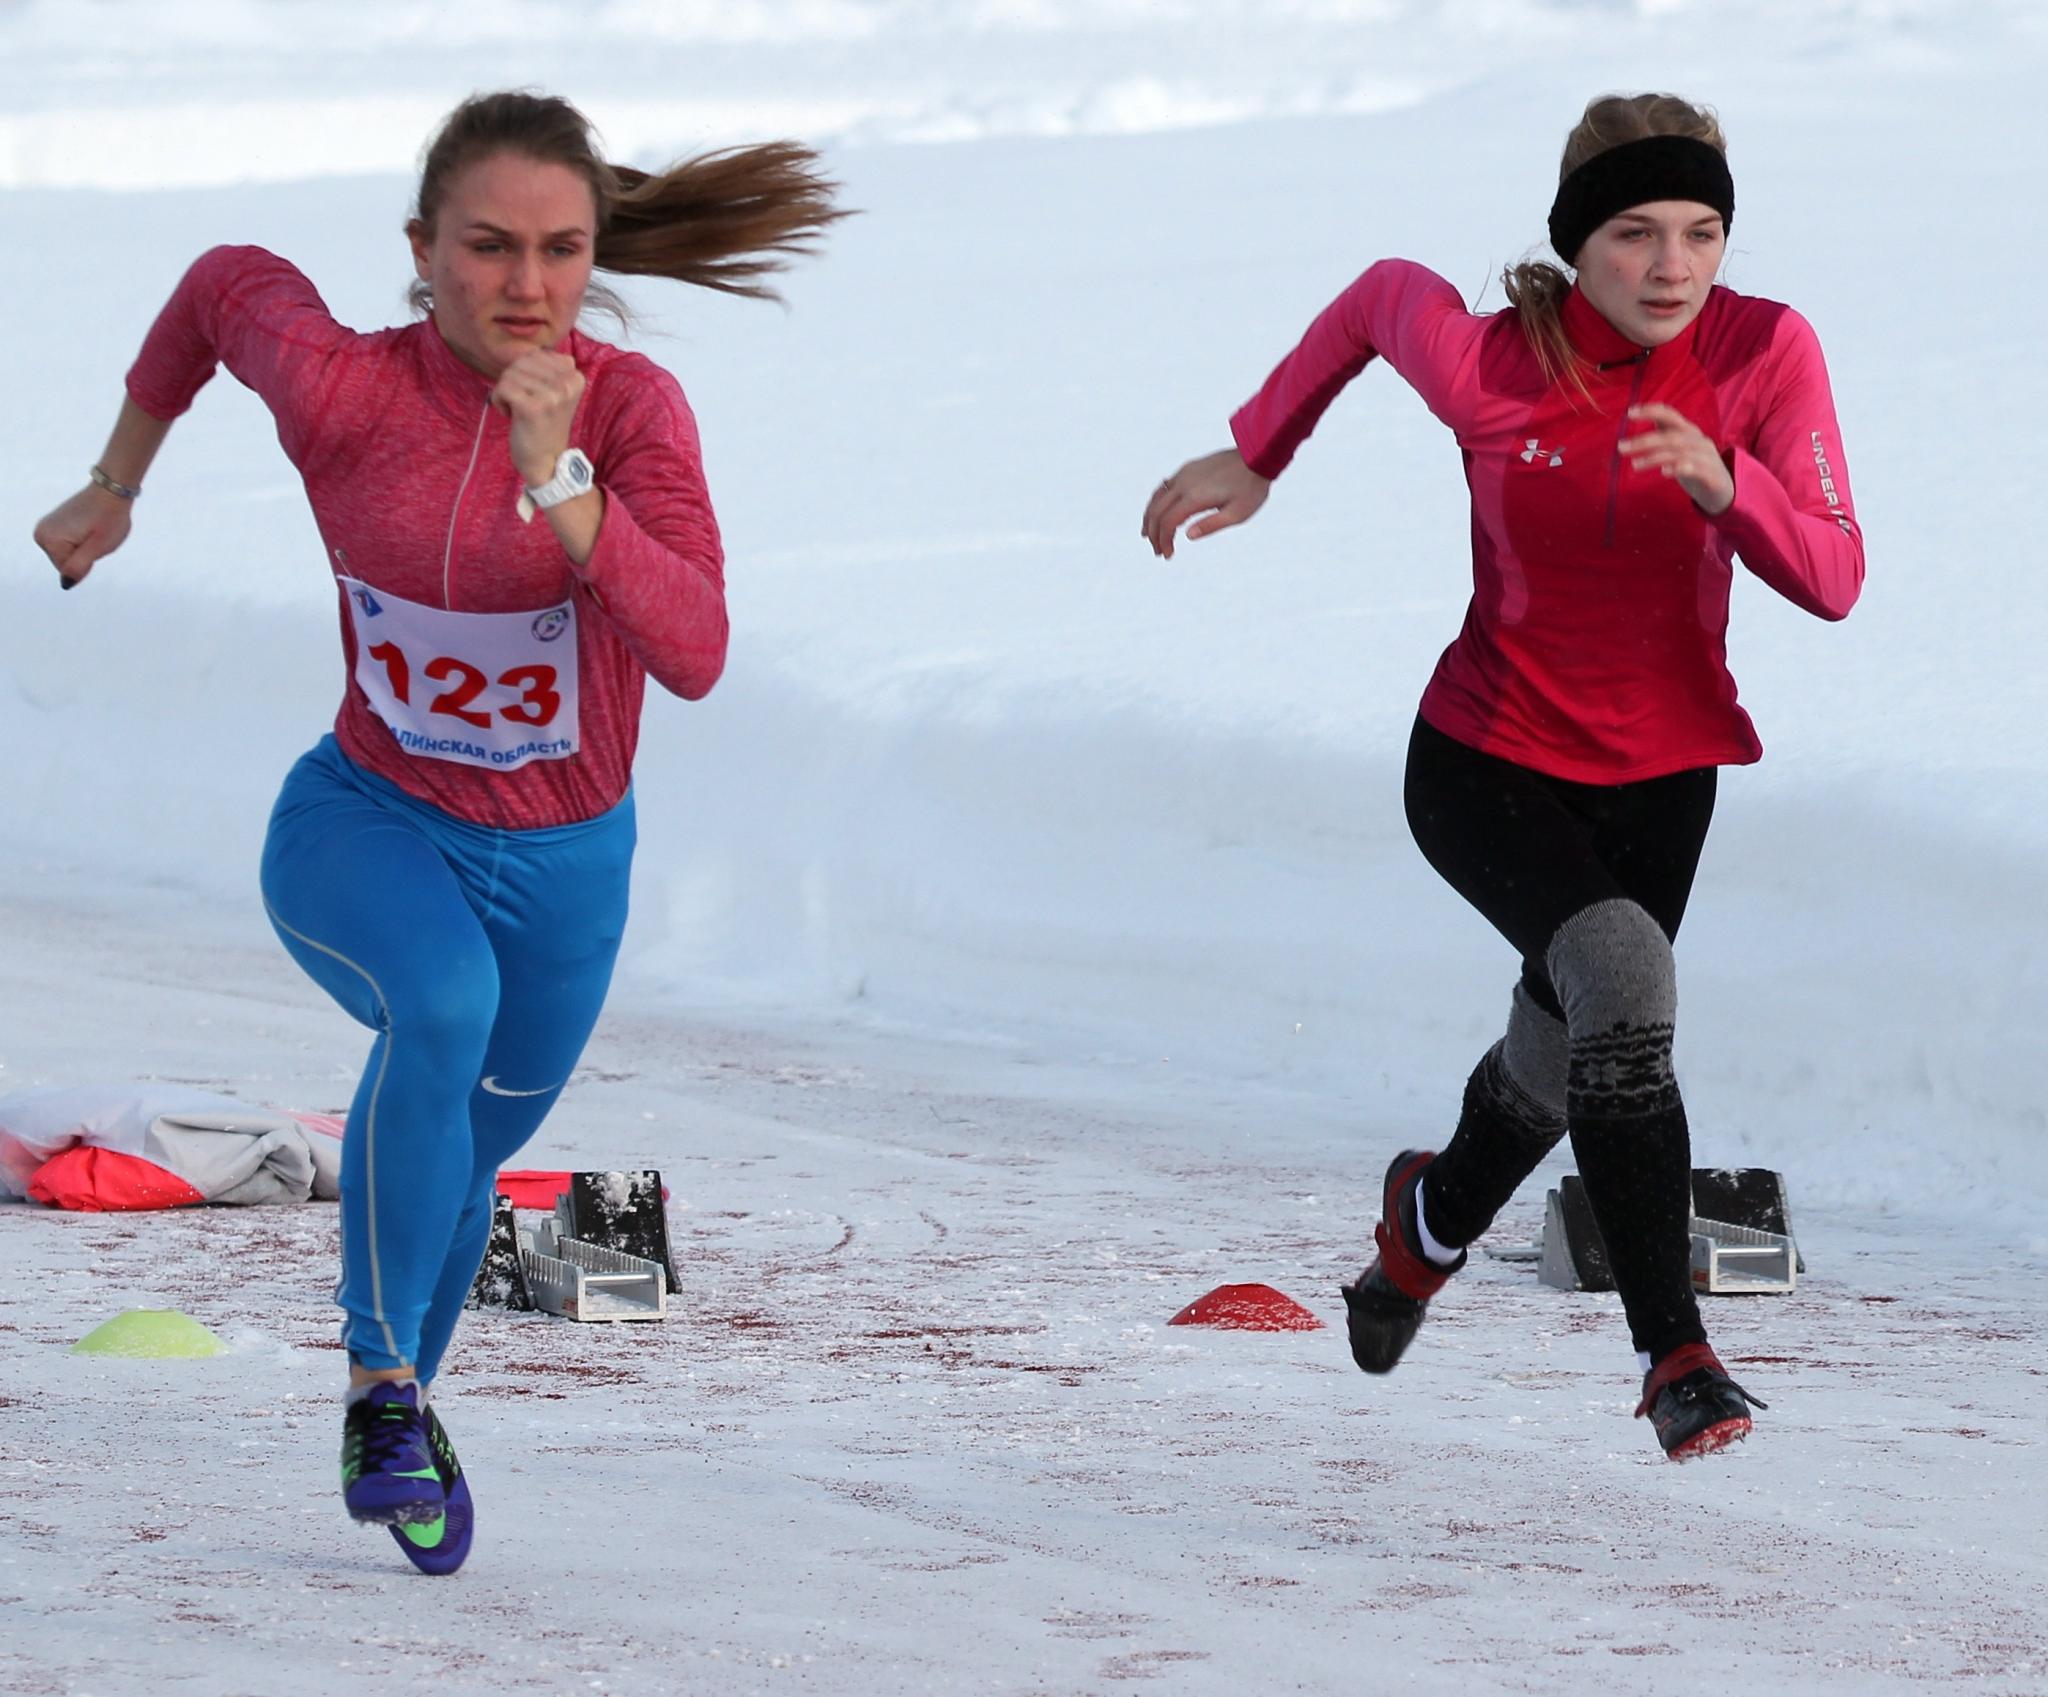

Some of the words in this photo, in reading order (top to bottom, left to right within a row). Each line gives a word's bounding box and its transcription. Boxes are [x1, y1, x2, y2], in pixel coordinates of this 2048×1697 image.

[1811, 431, 1840, 507] UNDER
[367, 640, 561, 729] 123
[491, 737, 572, 764] ОБЛАСТЬ
